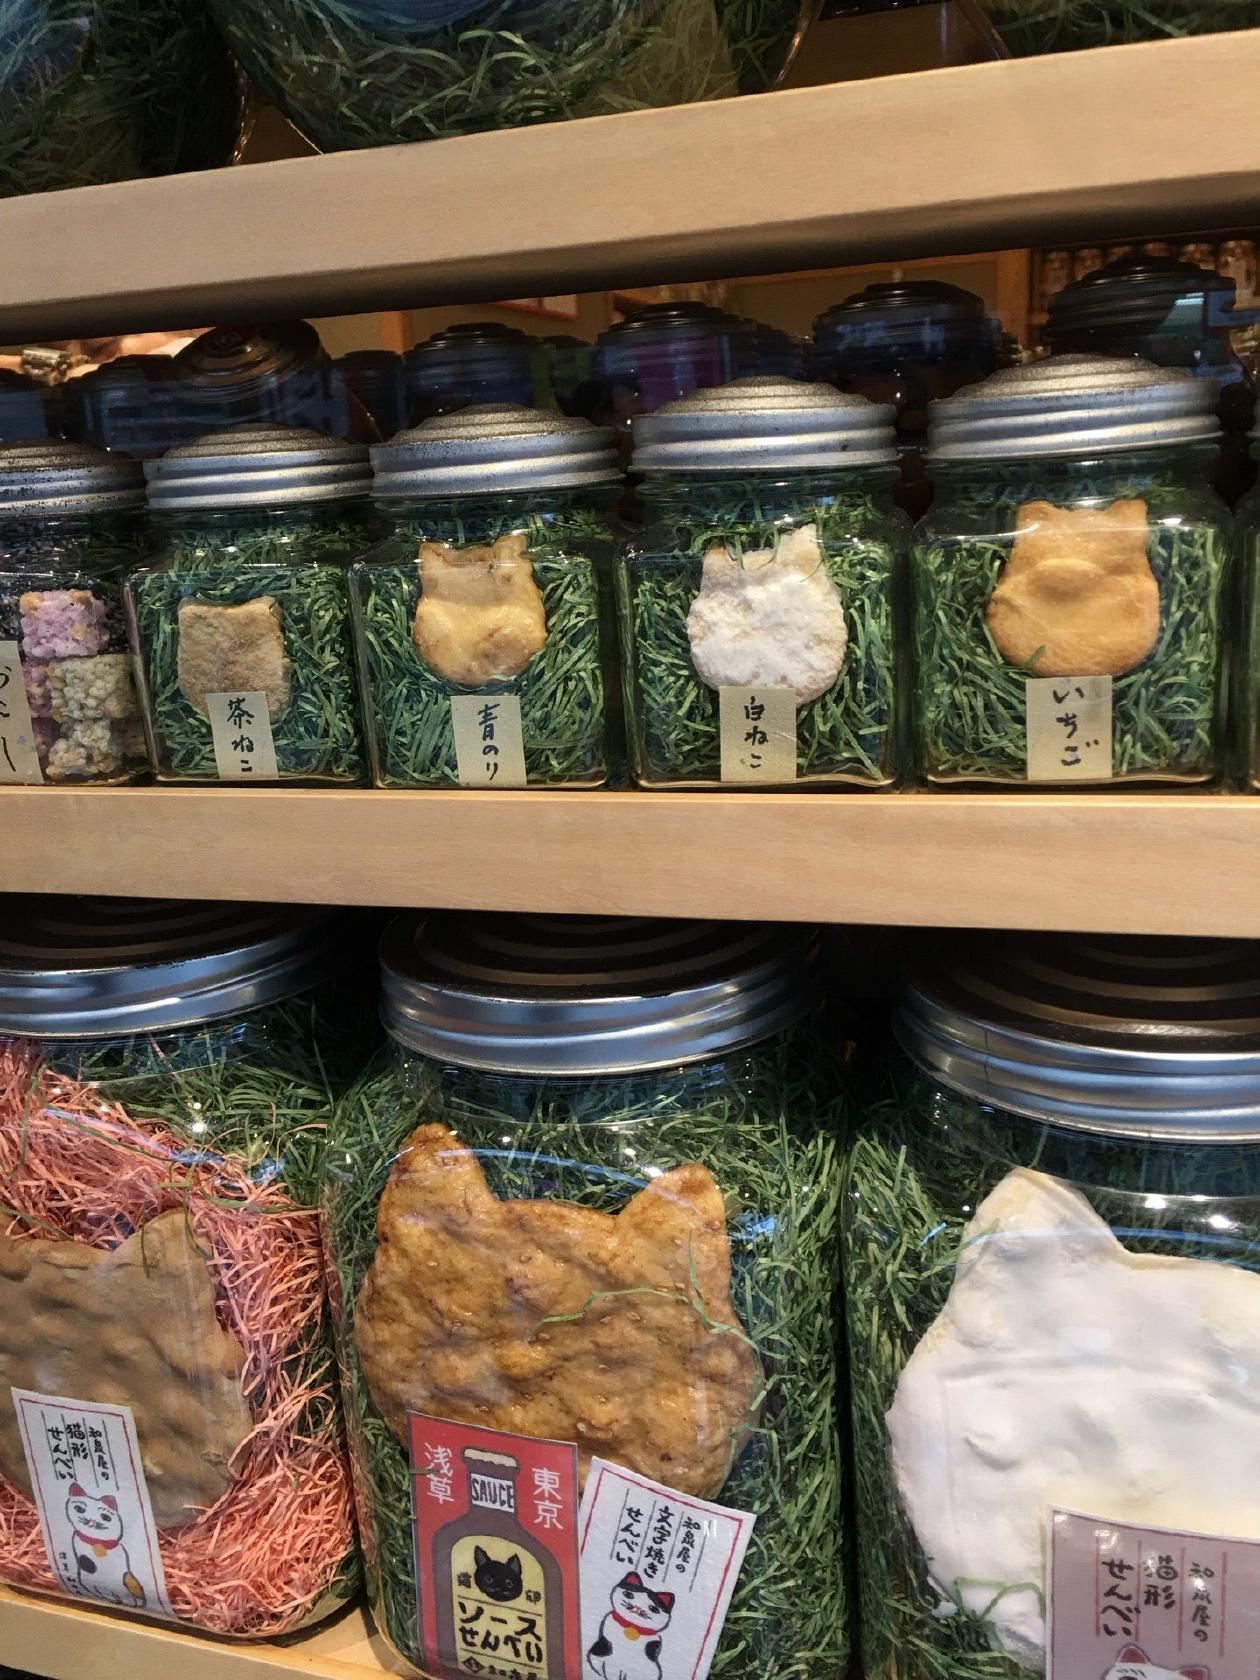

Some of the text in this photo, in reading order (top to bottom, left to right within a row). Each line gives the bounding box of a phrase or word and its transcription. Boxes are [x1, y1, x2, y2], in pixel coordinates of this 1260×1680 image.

[226, 697, 255, 772] 茶ねこ
[477, 703, 500, 781] 青のり
[743, 695, 769, 769] 白ねこ
[1052, 686, 1100, 767] いちご
[47, 1425, 74, 1480] せんべい
[66, 1422, 88, 1460] 猫形
[424, 1442, 455, 1505] 浅草
[471, 1477, 515, 1509] SAUCE
[531, 1466, 564, 1530] 東京
[615, 1506, 644, 1565] せんべい
[643, 1505, 675, 1579] 文字焼き
[675, 1516, 701, 1573] 和泉屋の
[1100, 1558, 1142, 1637] せんべい
[1143, 1554, 1179, 1610] 猫形
[458, 1601, 542, 1642] ソース
